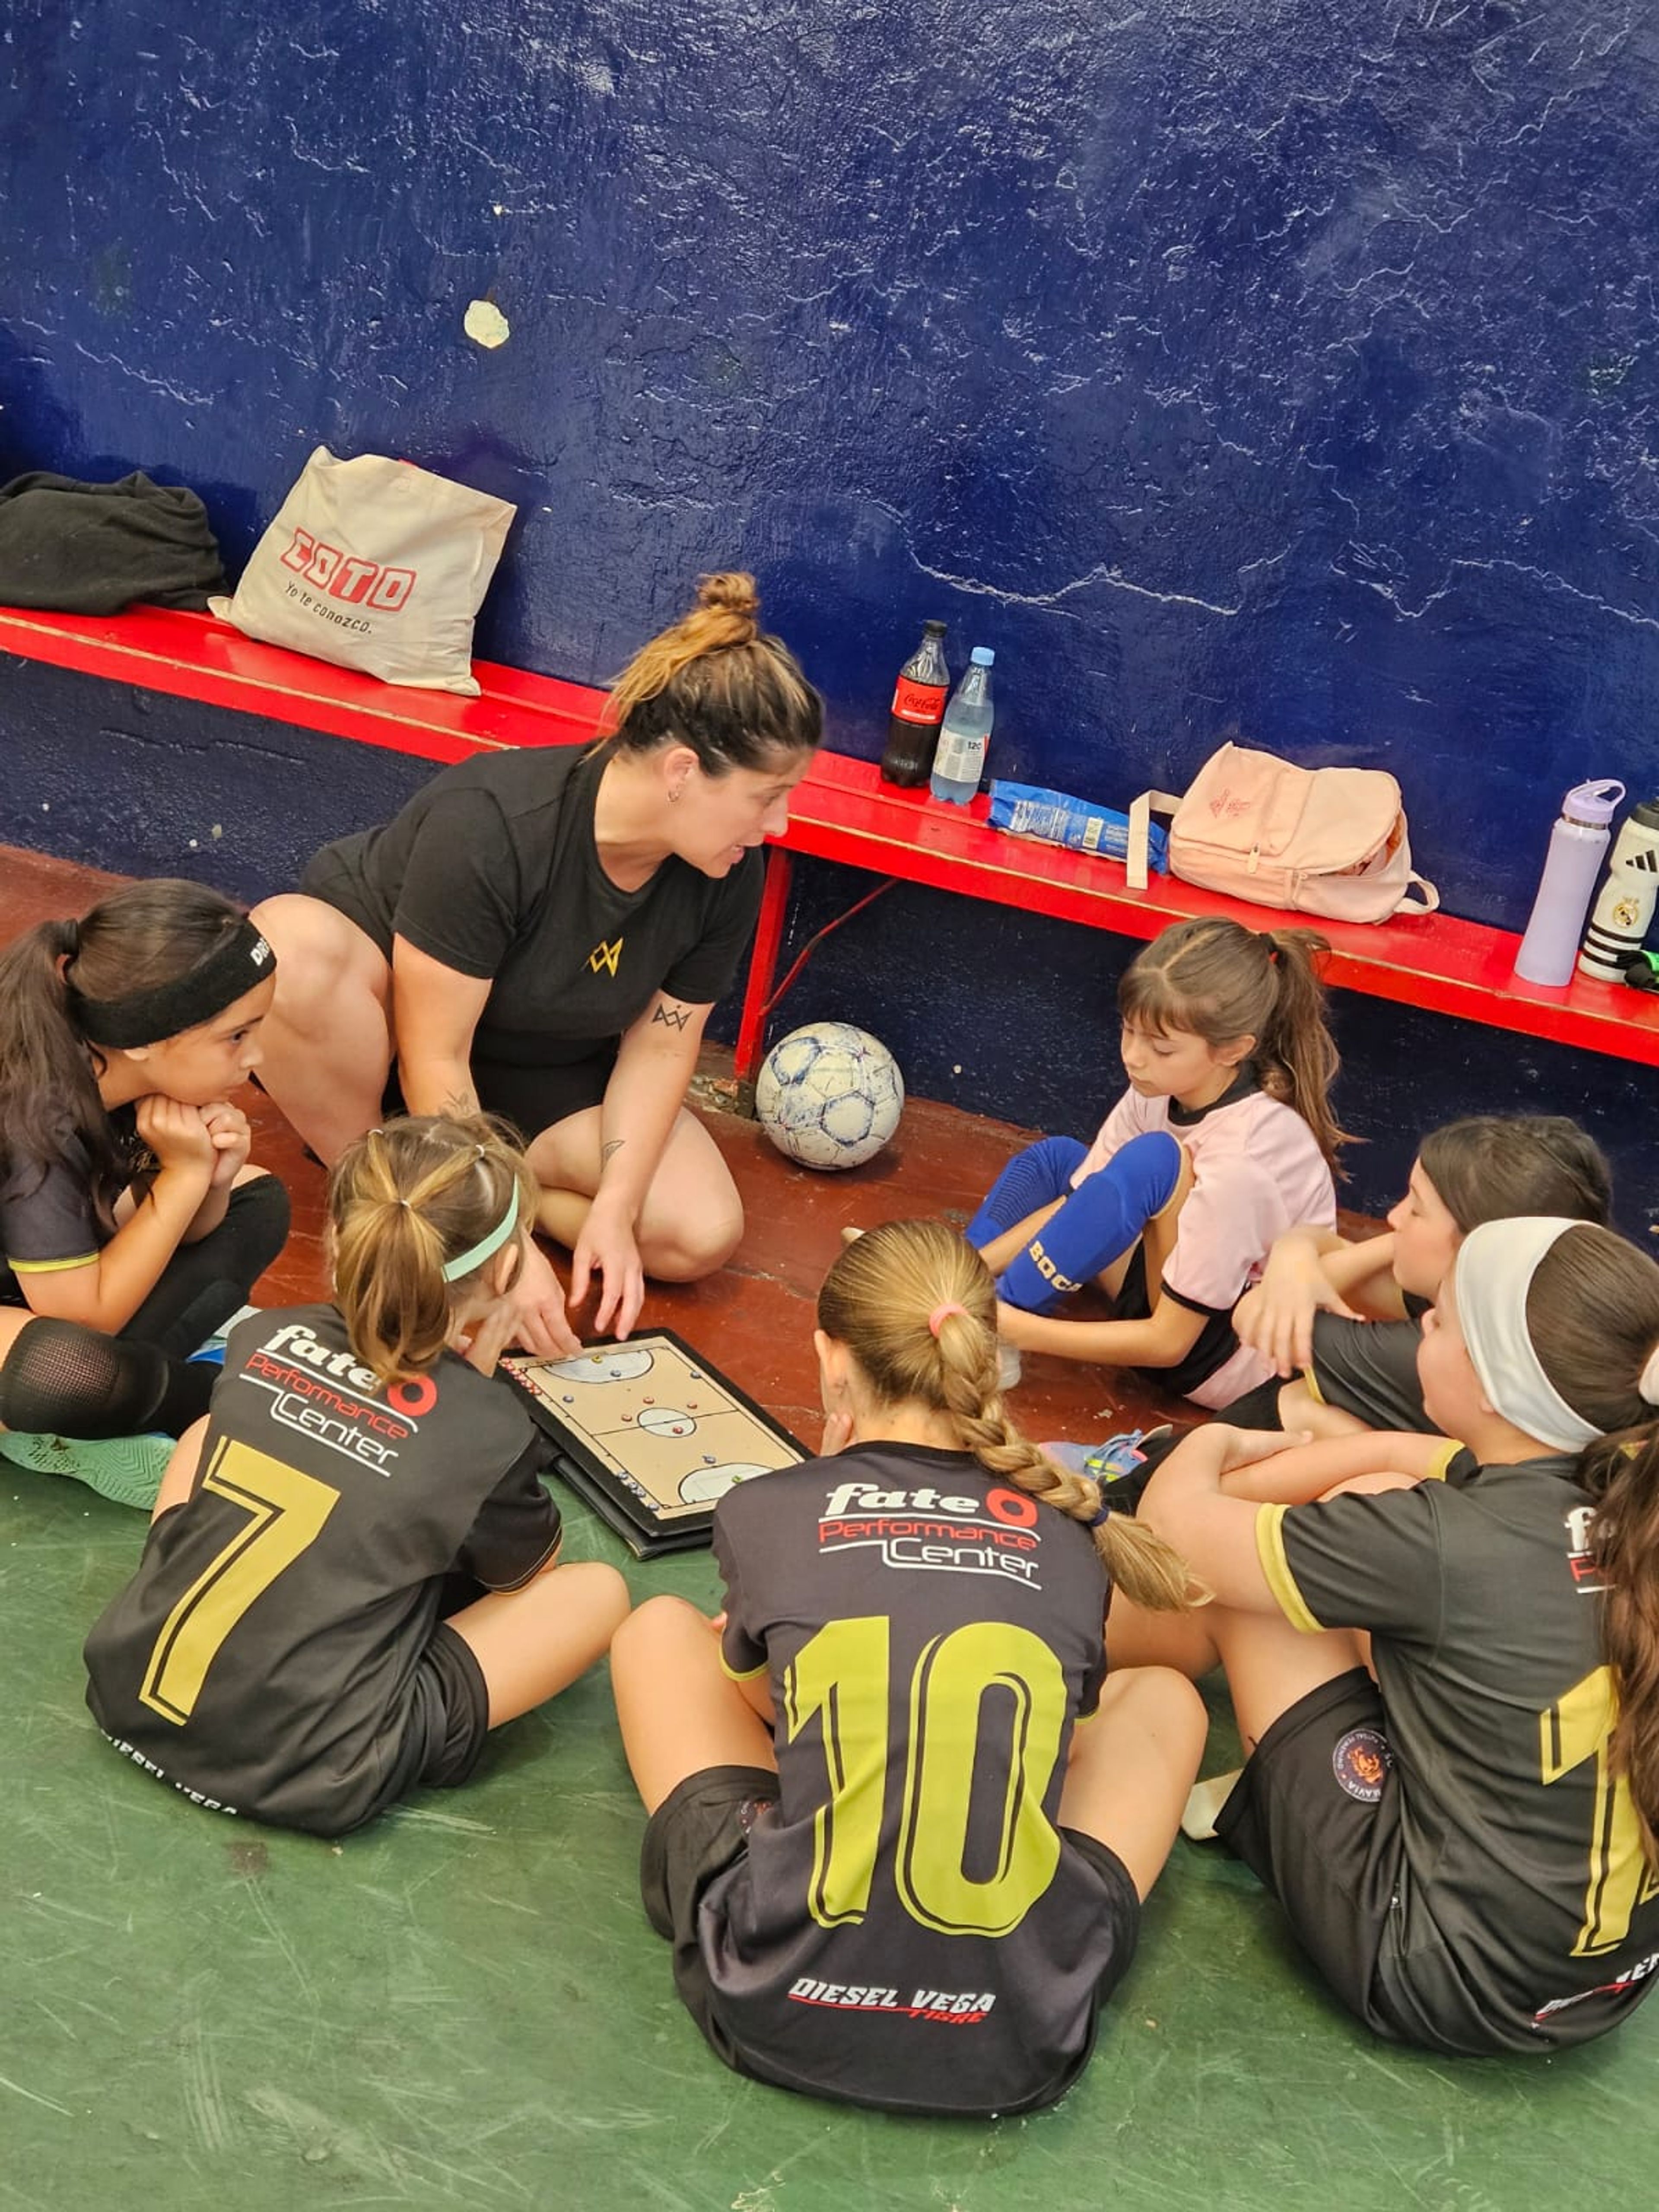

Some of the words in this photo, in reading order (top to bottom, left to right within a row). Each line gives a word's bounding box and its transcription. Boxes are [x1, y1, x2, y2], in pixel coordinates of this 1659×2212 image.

[281, 527, 417, 612] COTO
[285, 580, 298, 597] Yo
[300, 592, 312, 606] te
[313, 603, 372, 634] conozco.
[245, 1353, 409, 1440] Performance
[277, 1392, 399, 1465] Center
[818, 1518, 1037, 1551] Performance
[890, 1537, 1039, 1579] Center
[139, 1435, 341, 1726] 7
[784, 1615, 1068, 1938] 10
[788, 1977, 899, 2008] DIESEL
[911, 1989, 996, 2014] VEGA
